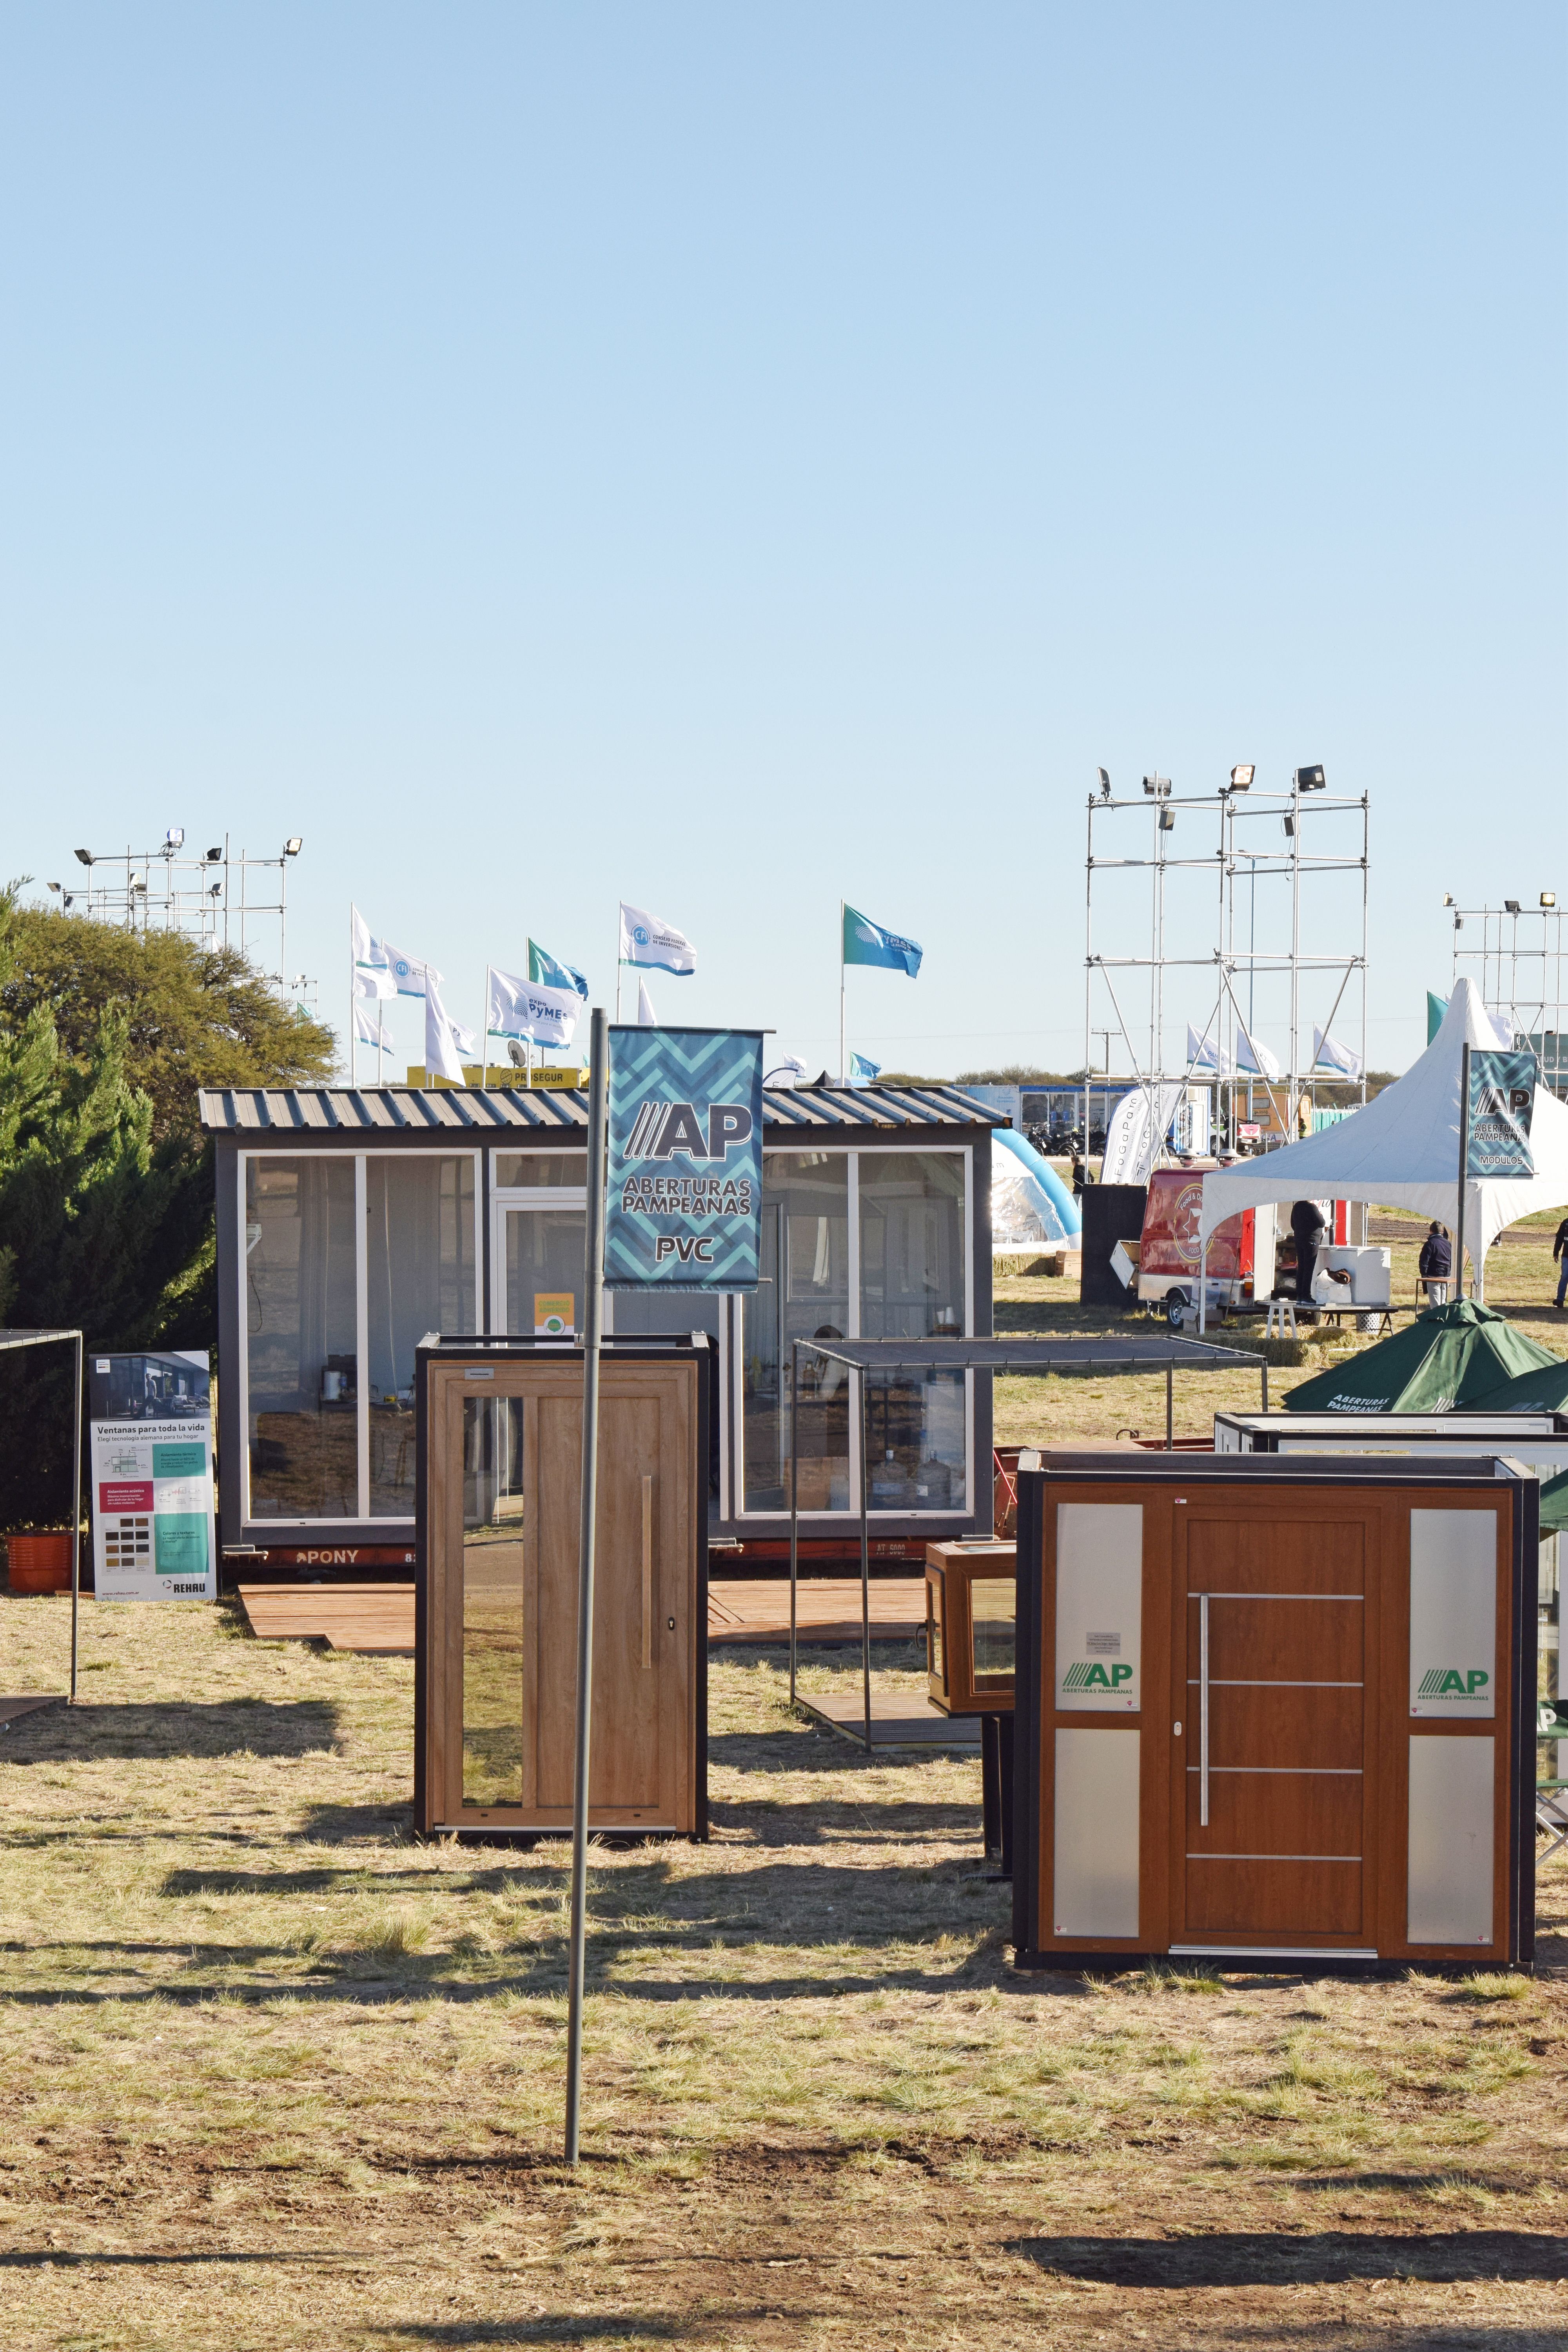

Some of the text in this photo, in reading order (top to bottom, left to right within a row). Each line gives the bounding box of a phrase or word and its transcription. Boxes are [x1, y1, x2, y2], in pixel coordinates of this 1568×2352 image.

[635, 931, 647, 941] CFI
[659, 941, 682, 950] INVERSIONES
[397, 964, 407, 973] CFI
[1207, 1051, 1224, 1062] PAMA
[515, 1073, 563, 1082] PRSEGUR
[1486, 1088, 1531, 1116] AP
[652, 1102, 753, 1162] AP
[1474, 1123, 1526, 1134] ABERTURAS
[1474, 1132, 1526, 1142] PAMPEANAS
[1479, 1155, 1523, 1165] MODULOS
[622, 1177, 751, 1198] ABERTURAS
[622, 1196, 751, 1216] PAMPEANAS
[1180, 1195, 1192, 1211] Food
[655, 1236, 714, 1263] PVC
[1333, 1394, 1390, 1405] ABERTURAS
[1327, 1401, 1383, 1412] PAMPEANAS
[877, 1544, 886, 1555] AT
[308, 1550, 359, 1564] PONY
[173, 1583, 205, 1593] REHAU
[1083, 1663, 1133, 1687] AP
[1438, 1670, 1489, 1694] AP
[1537, 1709, 1557, 1731] P
